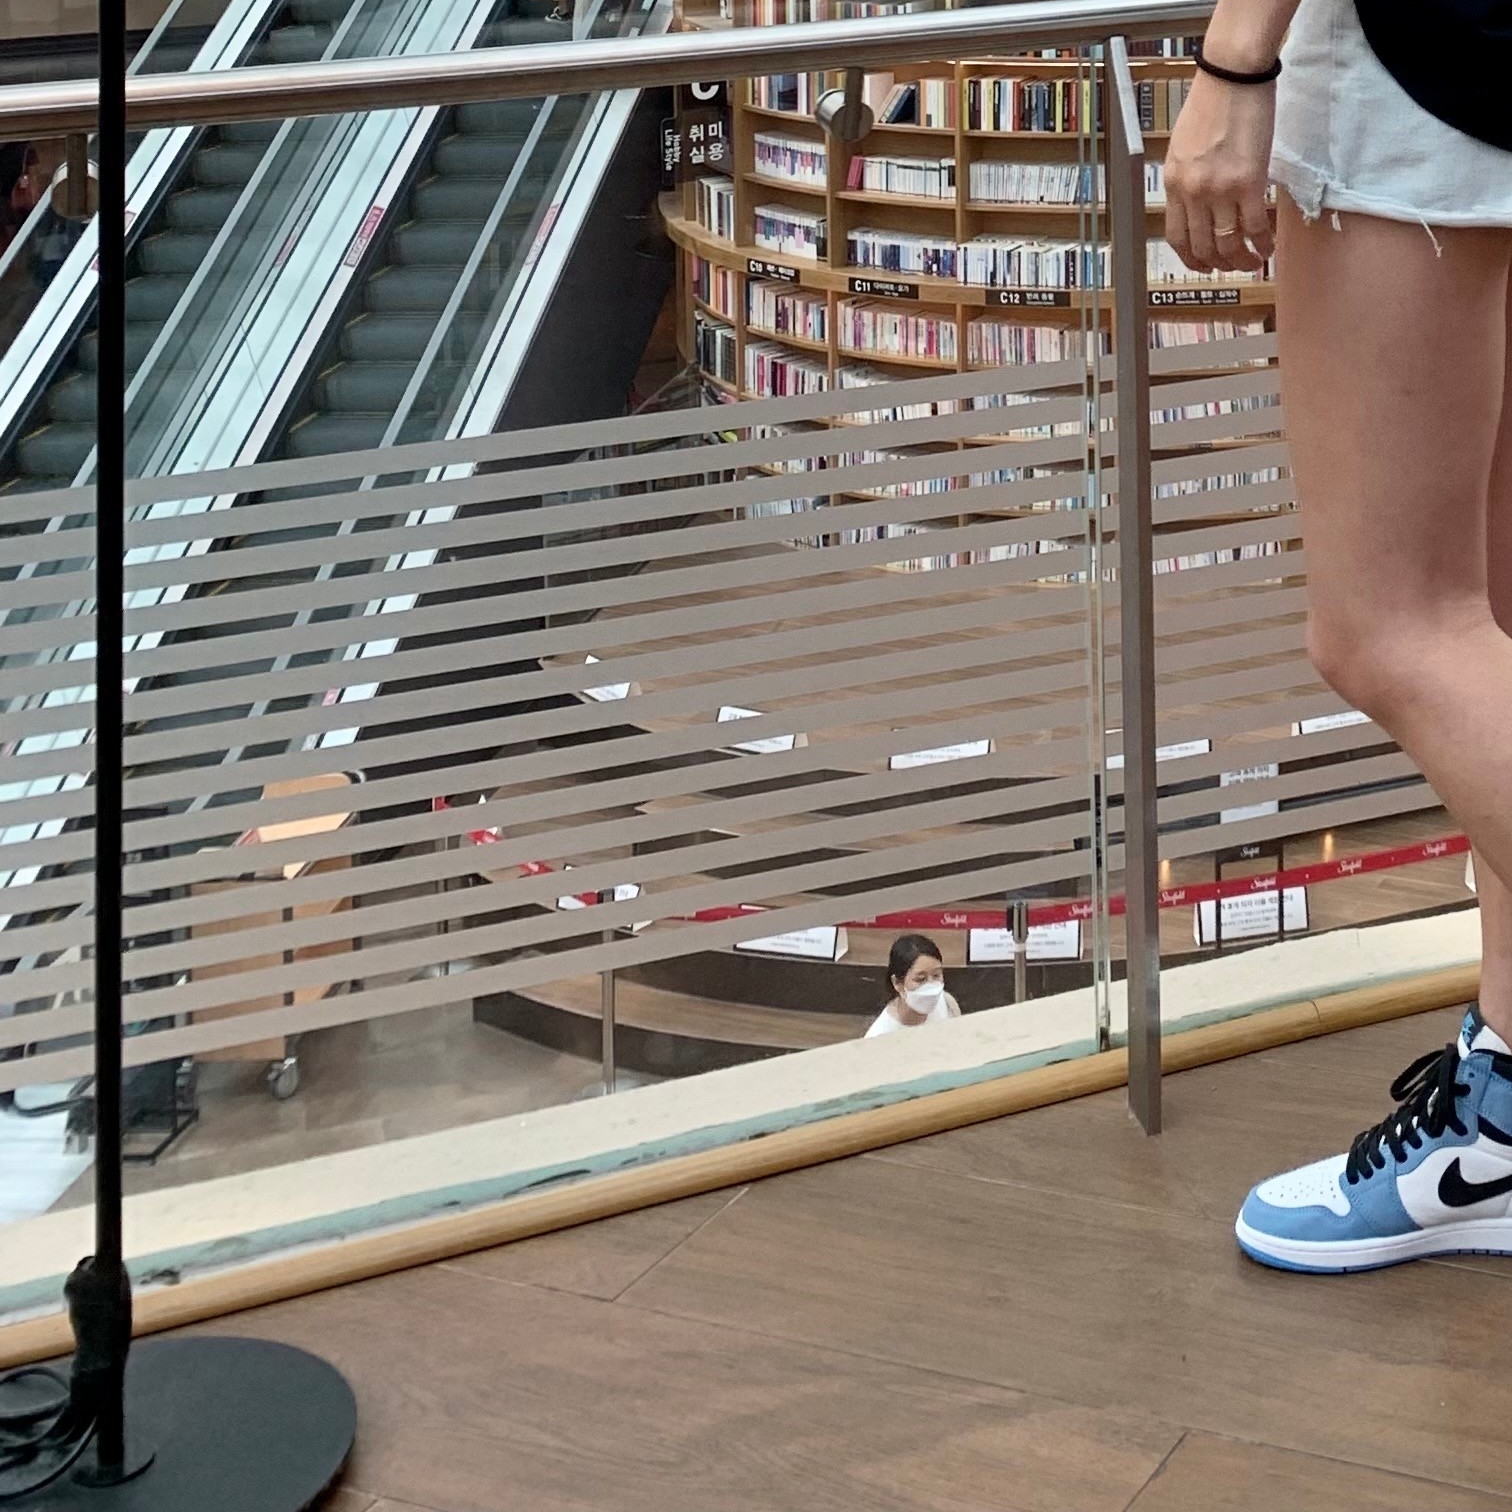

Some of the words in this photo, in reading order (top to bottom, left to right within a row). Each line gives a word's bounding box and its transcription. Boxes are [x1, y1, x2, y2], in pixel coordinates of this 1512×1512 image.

[689, 120, 723, 143] 취미
[854, 279, 871, 292] C11
[1000, 291, 1020, 304] C12
[1151, 292, 1174, 304] C13
